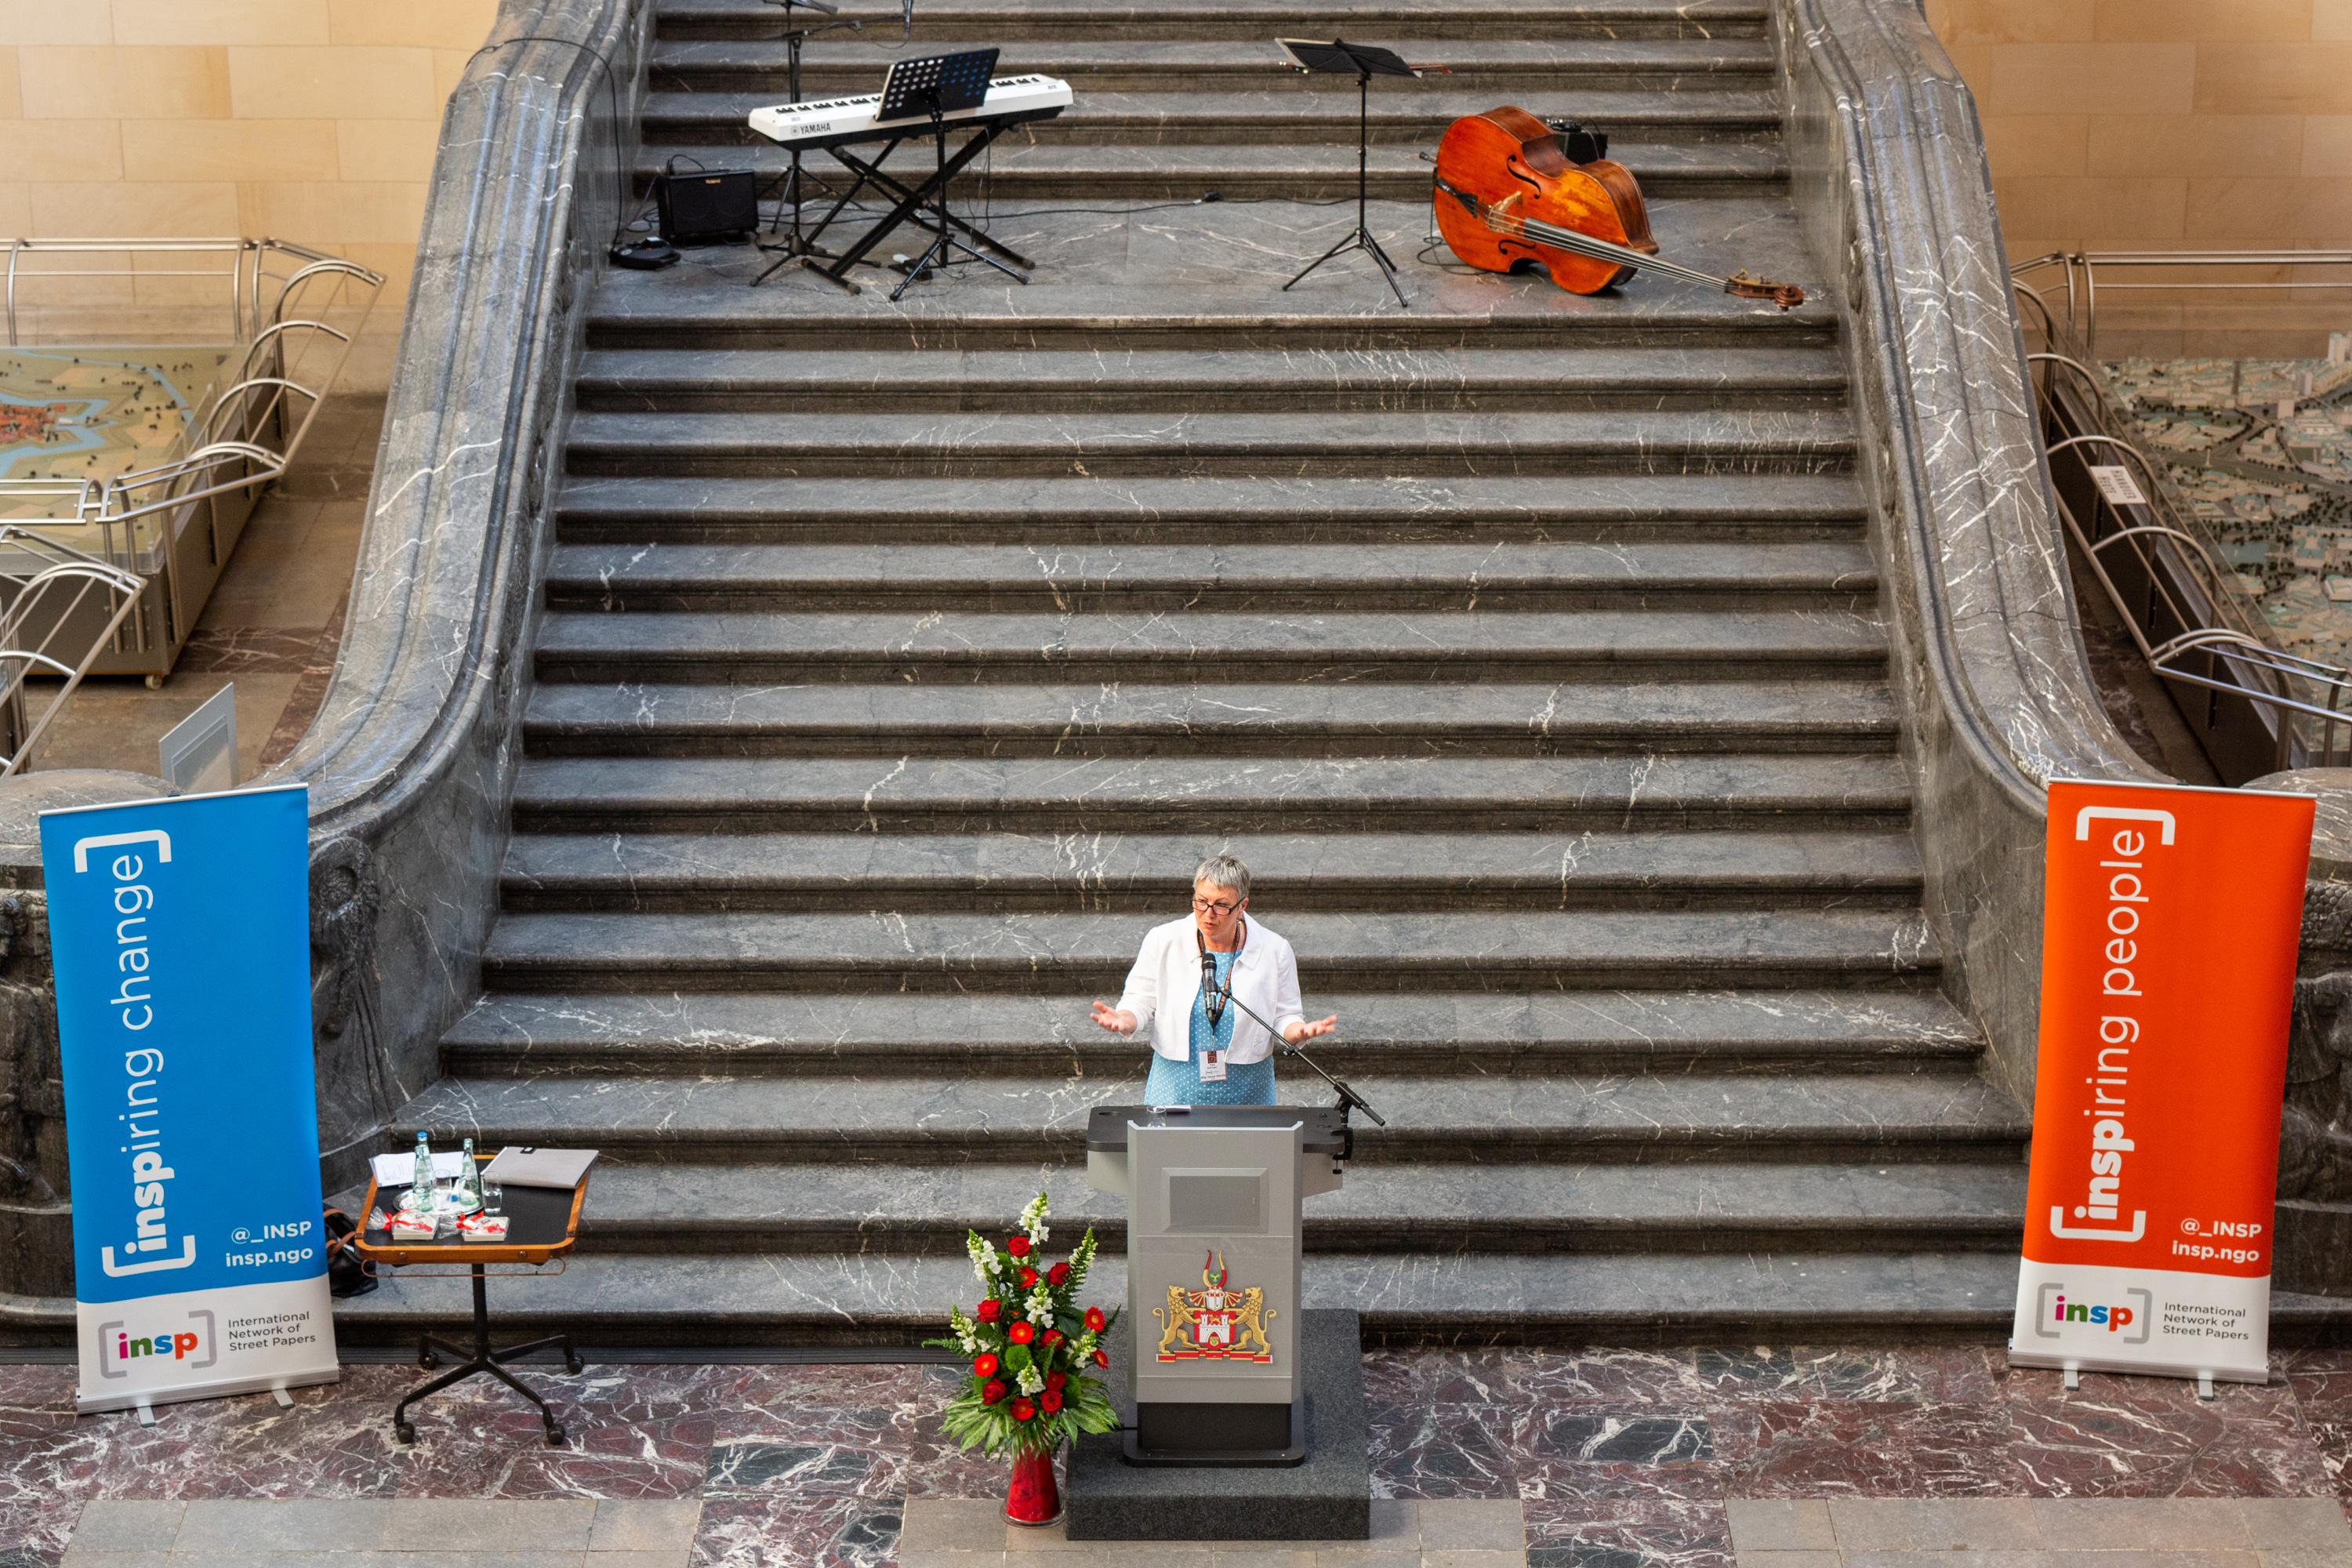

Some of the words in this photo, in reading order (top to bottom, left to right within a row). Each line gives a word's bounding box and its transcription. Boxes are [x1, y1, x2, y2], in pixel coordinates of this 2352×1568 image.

[800, 122, 832, 135] YAMAHA
[230, 1221, 312, 1245] @_INSP
[2180, 1218, 2262, 1239] @_INSP
[226, 1247, 313, 1268] insp.ngo
[2172, 1240, 2260, 1264] insp.ngo
[2164, 1302, 2247, 1317] International
[228, 1311, 310, 1328] International
[2164, 1313, 2218, 1327] Network
[2222, 1319, 2236, 1327] of
[229, 1323, 284, 1339] Network
[287, 1322, 302, 1334] of
[2163, 1324, 2201, 1338] Street
[2205, 1328, 2249, 1342] Papers
[230, 1338, 270, 1351] Street
[272, 1335, 316, 1348] Papers
